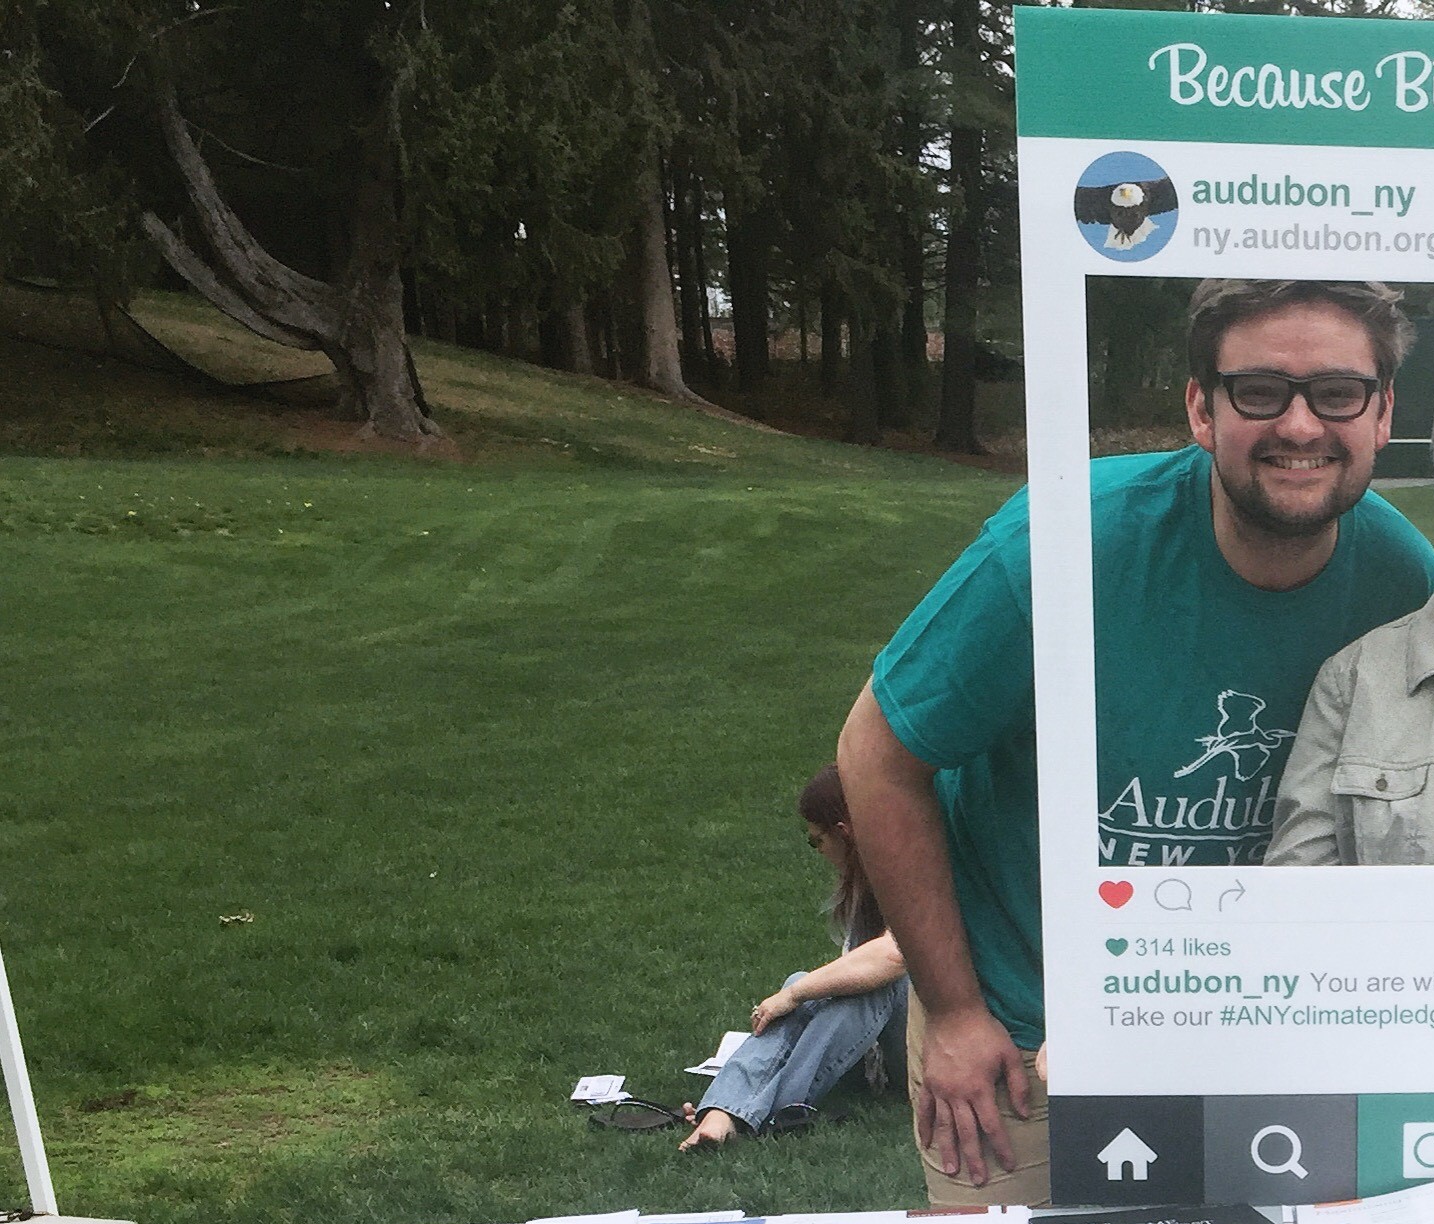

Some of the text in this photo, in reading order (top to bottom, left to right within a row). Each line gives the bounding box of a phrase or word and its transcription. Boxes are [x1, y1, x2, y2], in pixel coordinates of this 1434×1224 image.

[1148, 42, 1371, 113] Because
[1191, 174, 1416, 217] audubon_ny
[1135, 938, 1231, 956] 314 likes
[1103, 970, 1300, 1000] audubon_ny
[1310, 972, 1357, 993] You
[1366, 976, 1405, 992] are
[1104, 1006, 1165, 1027] Take
[1173, 1010, 1213, 1026] our
